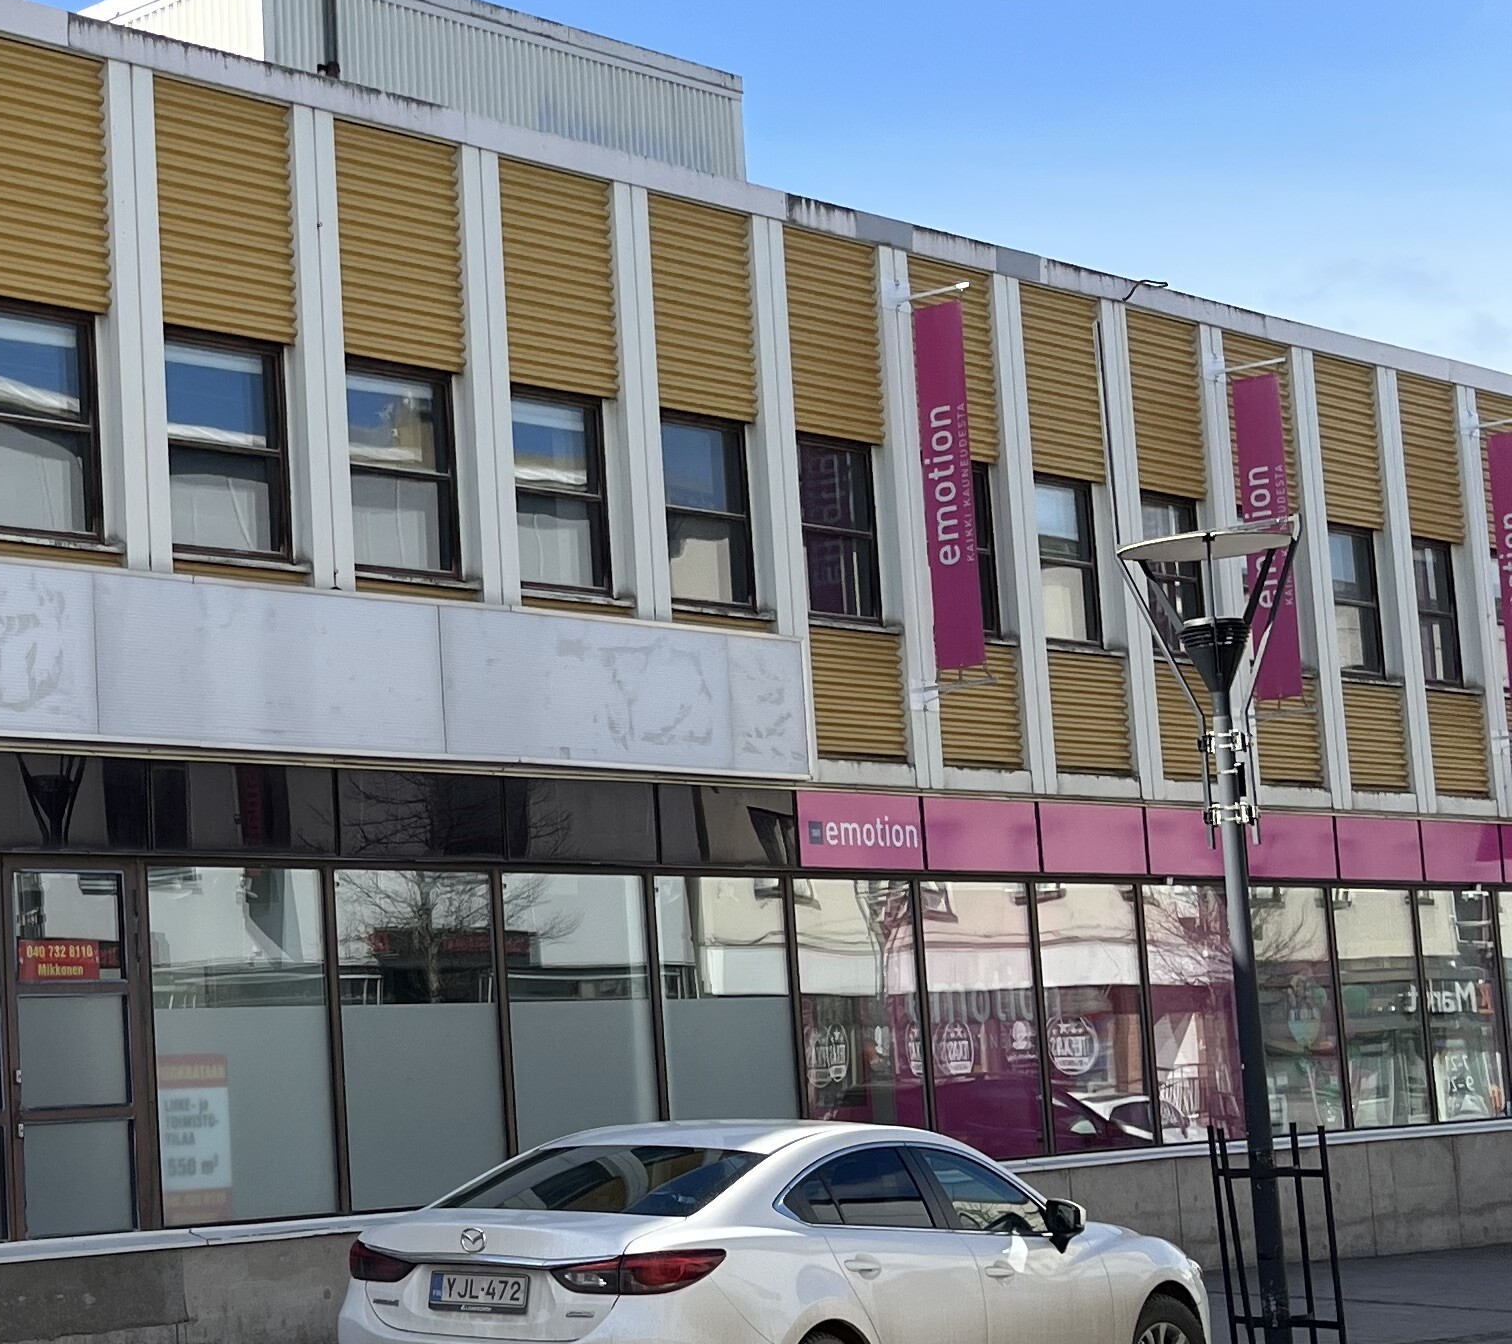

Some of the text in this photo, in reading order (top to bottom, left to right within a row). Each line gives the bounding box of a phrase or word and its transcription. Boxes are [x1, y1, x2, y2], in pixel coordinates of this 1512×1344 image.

[924, 405, 961, 565] emotion
[956, 403, 975, 562] KAIKKI KAUNEUDESTA
[826, 815, 918, 848] emotion
[26, 945, 45, 958] 040
[37, 963, 84, 976] Mikkonen
[167, 1157, 197, 1177] 550
